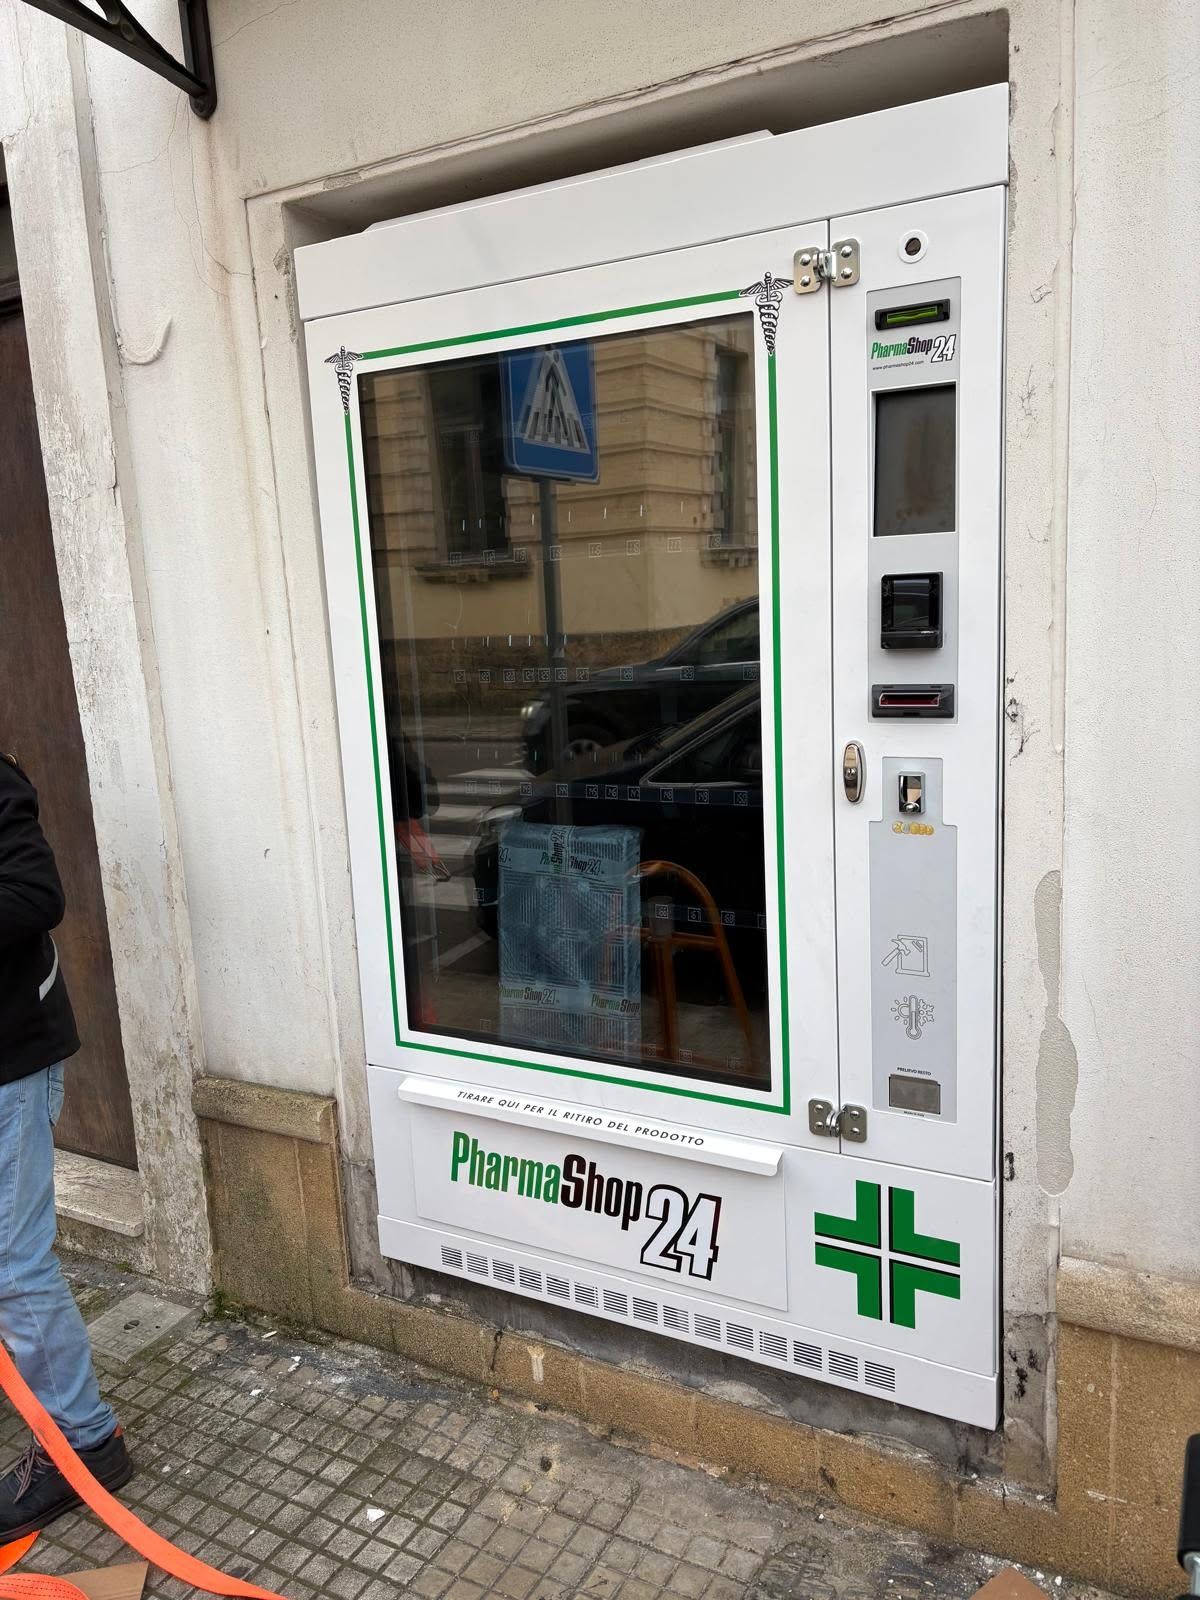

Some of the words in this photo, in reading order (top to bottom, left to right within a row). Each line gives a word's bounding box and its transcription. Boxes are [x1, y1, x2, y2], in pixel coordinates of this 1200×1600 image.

[871, 334, 956, 363] PharmaShop24
[457, 1091, 494, 1104] TIRARE
[498, 1099, 520, 1109] QUI
[523, 1104, 544, 1114] PER
[548, 1108, 557, 1117] IL
[563, 1111, 602, 1126] RITIRO
[607, 1121, 629, 1131] DEL
[635, 1126, 704, 1146] PRODOTTO
[451, 1131, 722, 1281] PharmaShop24
